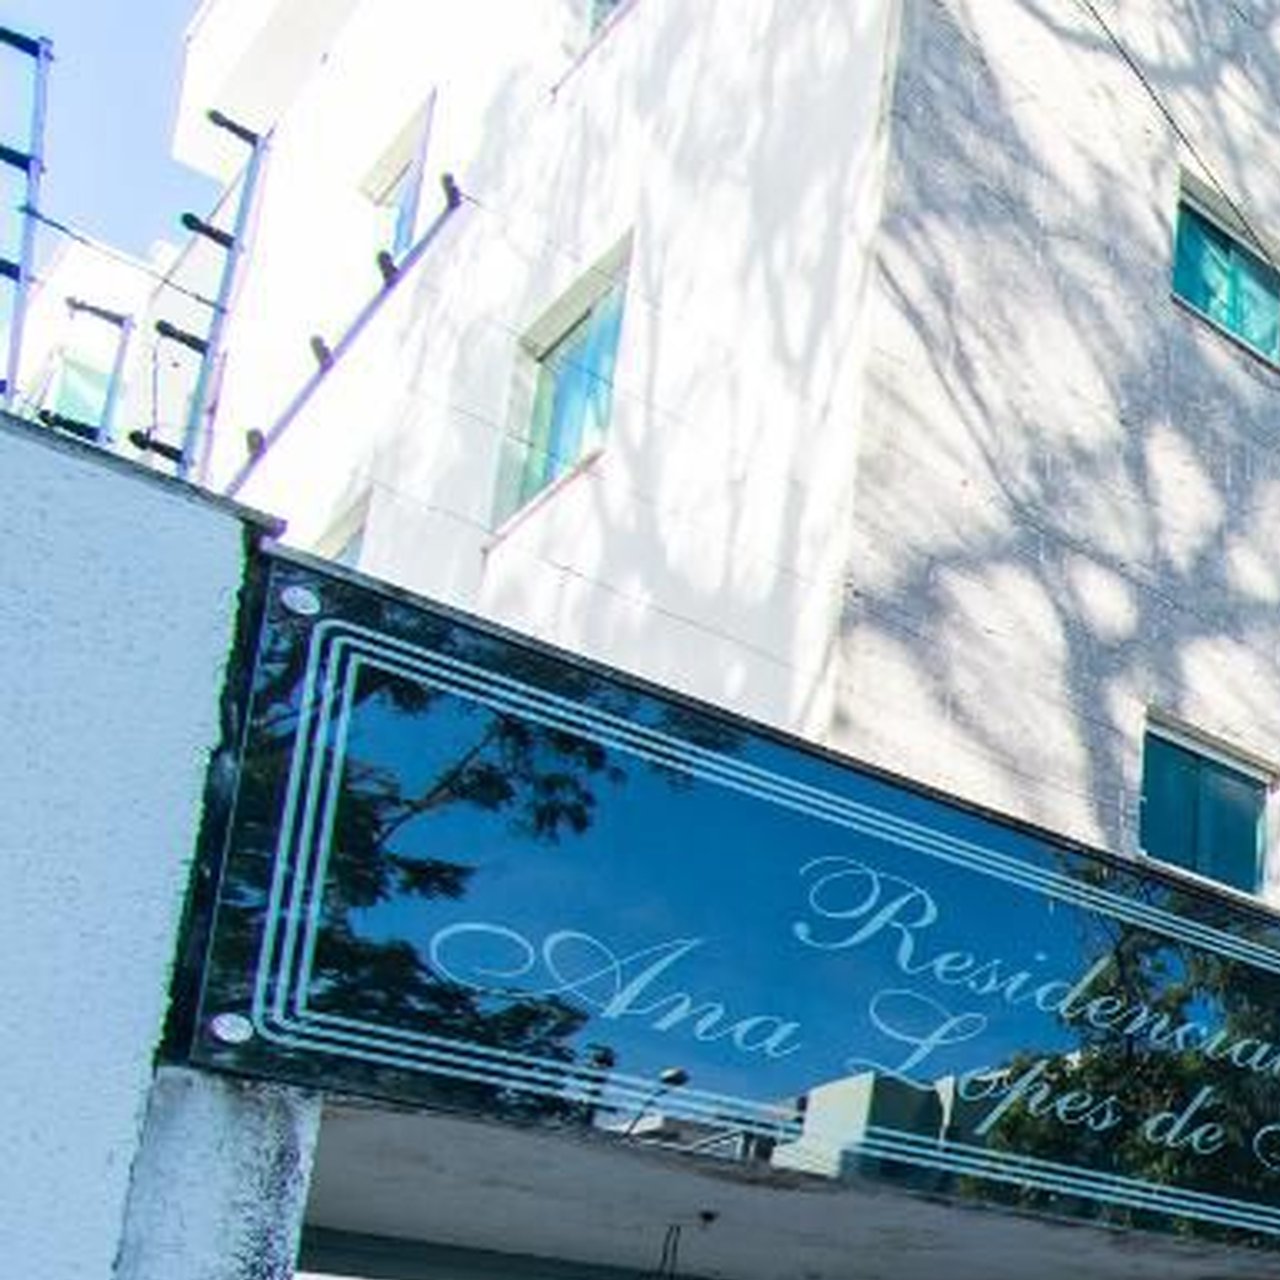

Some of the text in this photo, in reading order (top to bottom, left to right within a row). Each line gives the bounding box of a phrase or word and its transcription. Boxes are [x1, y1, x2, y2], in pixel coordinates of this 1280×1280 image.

[428, 920, 801, 1061] Ana
[847, 988, 1124, 1137] Lopes
[1144, 1084, 1225, 1158] de
